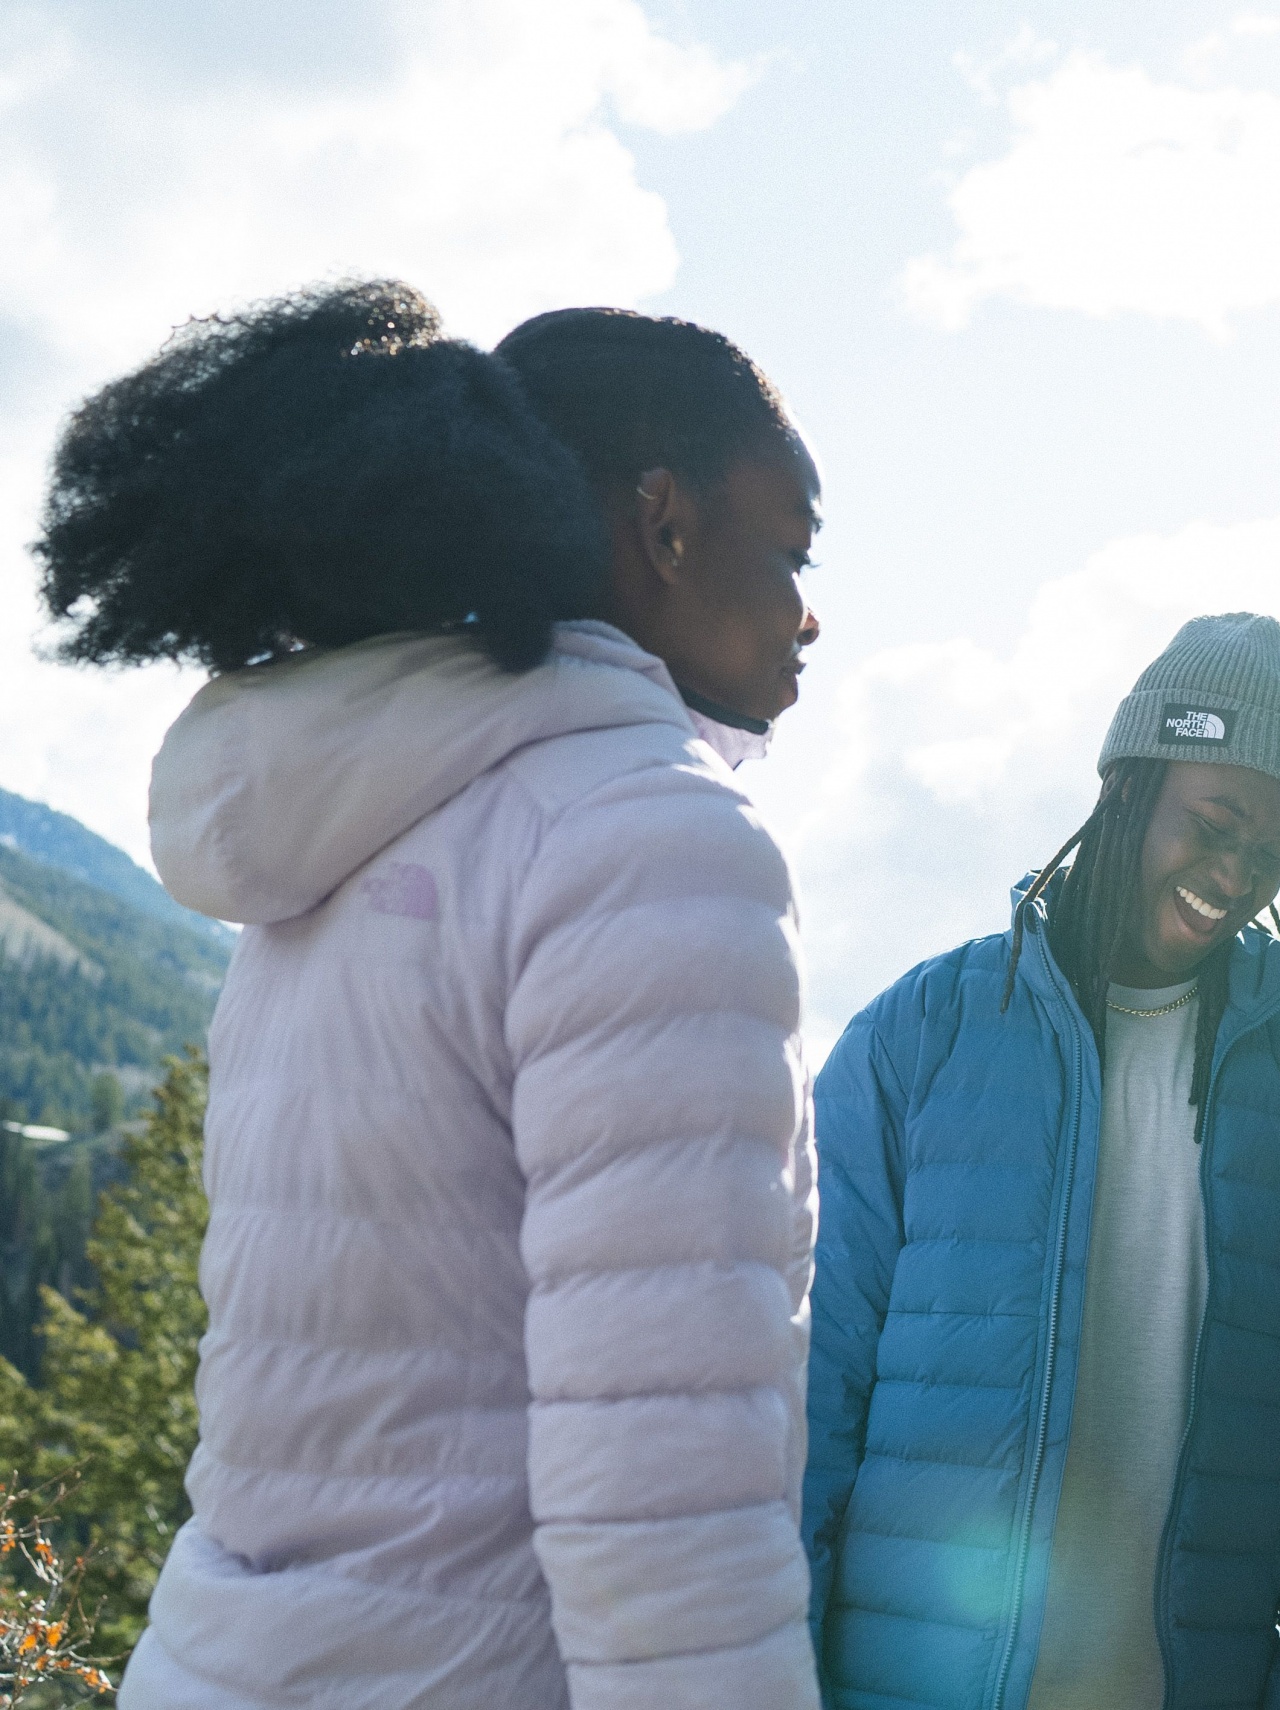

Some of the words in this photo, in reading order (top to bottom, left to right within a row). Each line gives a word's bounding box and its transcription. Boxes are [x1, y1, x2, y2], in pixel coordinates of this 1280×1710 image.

[1186, 711, 1207, 721] THE
[1166, 718, 1206, 729] NORTH
[1175, 728, 1204, 738] FACE
